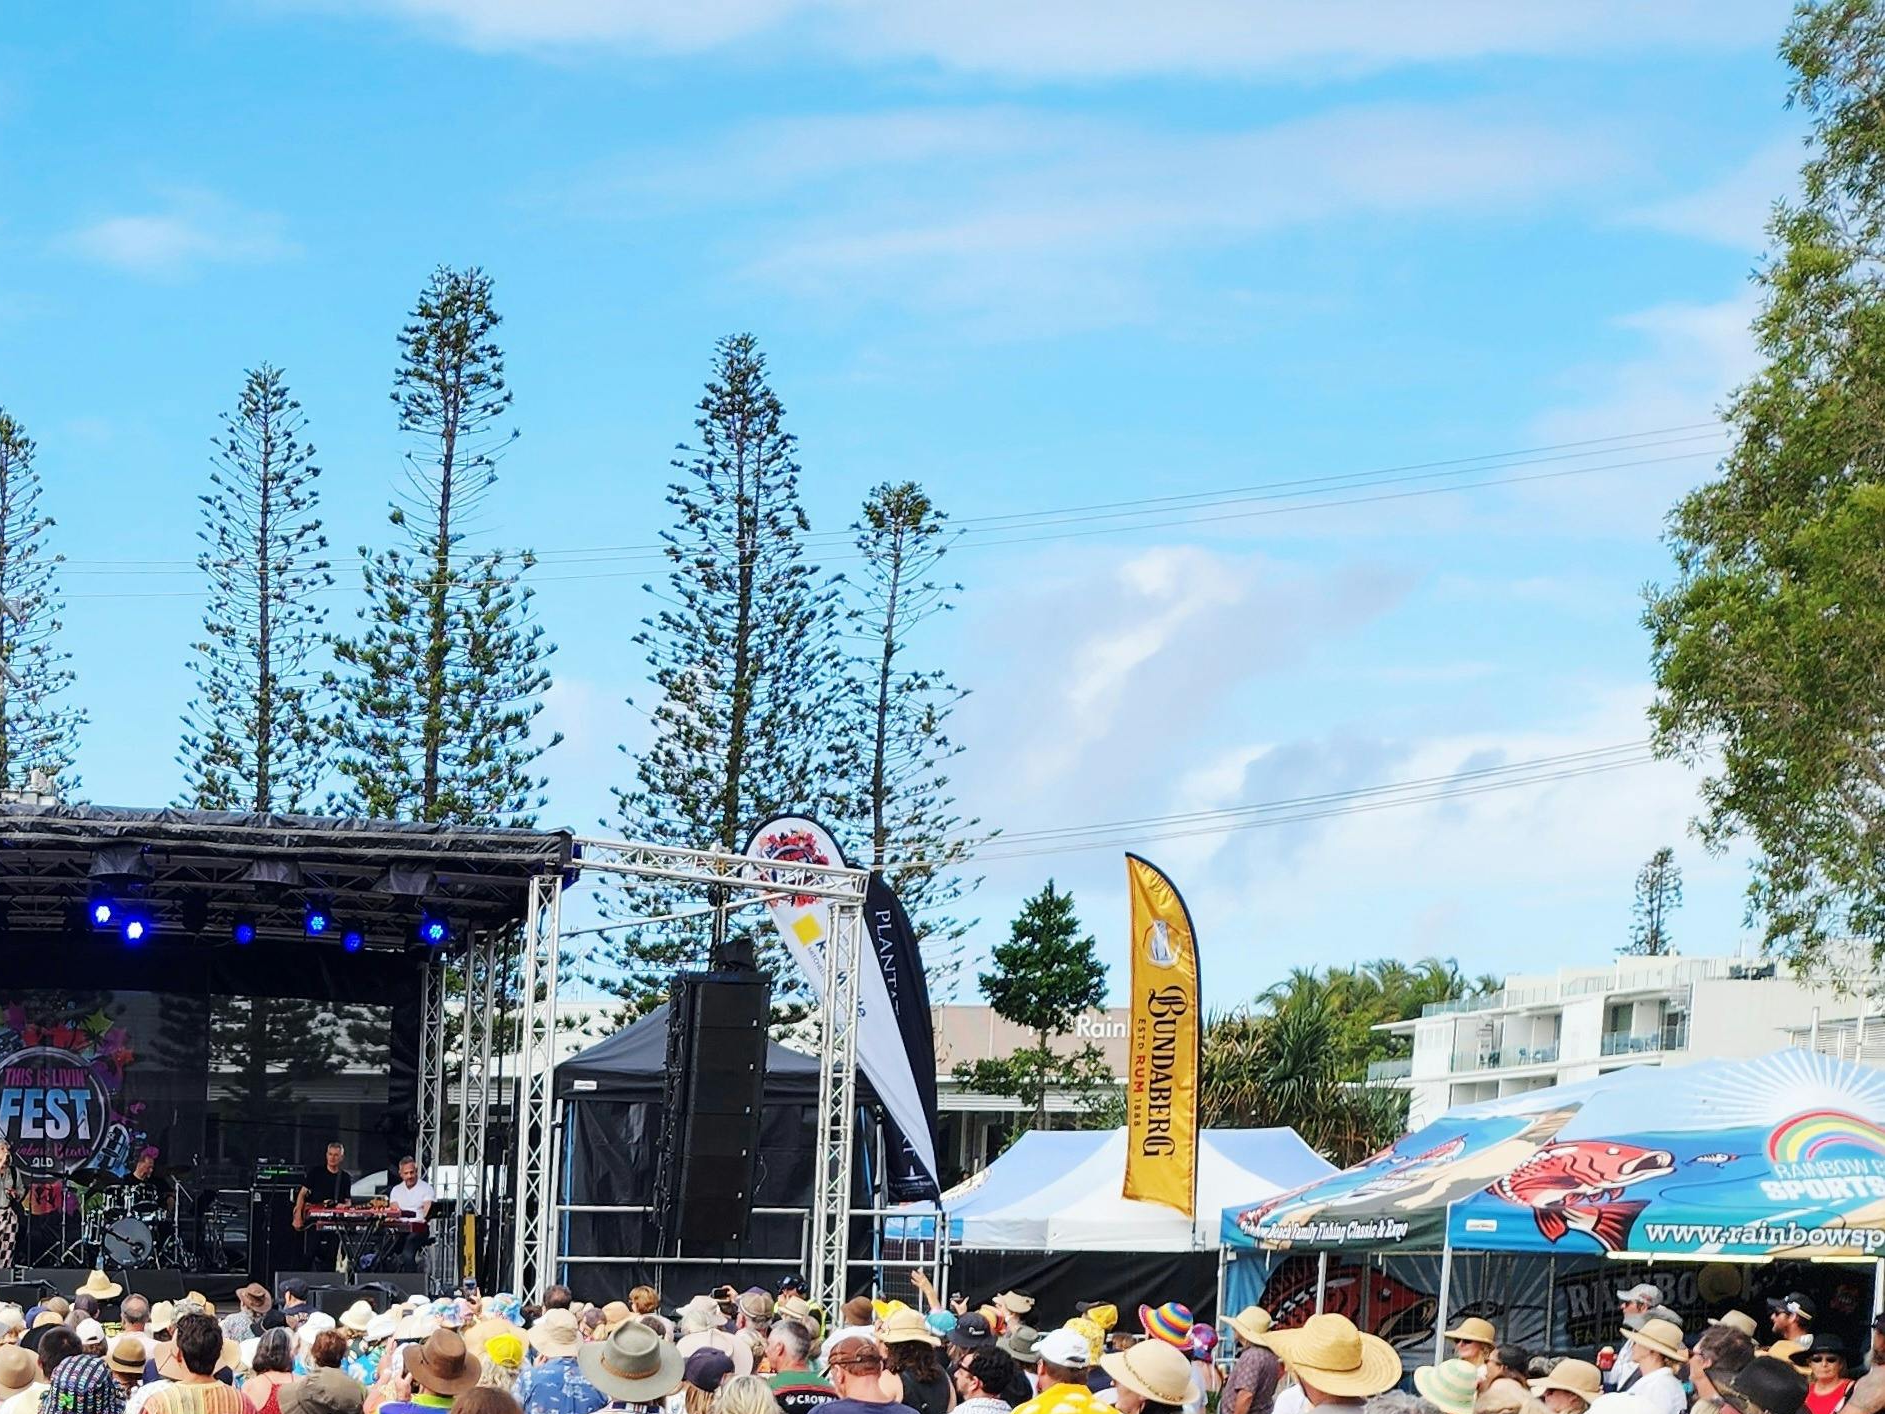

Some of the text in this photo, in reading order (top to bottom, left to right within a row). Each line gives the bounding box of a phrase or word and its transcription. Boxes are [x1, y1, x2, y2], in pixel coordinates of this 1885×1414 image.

[1076, 1015, 1131, 1038] Rain
[4, 1067, 33, 1087] THIS
[36, 1068, 49, 1087] IS
[1134, 1018, 1146, 1127] ESTD RUM 1888
[1143, 985, 1188, 1157] BUNDABERG
[30, 1157, 54, 1168] QLD
[1773, 1158, 1868, 1179] RAINBOW
[1759, 1174, 1885, 1201] SPORTS
[1291, 1221, 1318, 1244] Family
[1316, 1221, 1346, 1245] Fishing
[1346, 1220, 1377, 1239] Classic
[1377, 1219, 1386, 1239] &
[1385, 1218, 1409, 1243] Expo
[1644, 1221, 1885, 1254] www.rainbowsp
